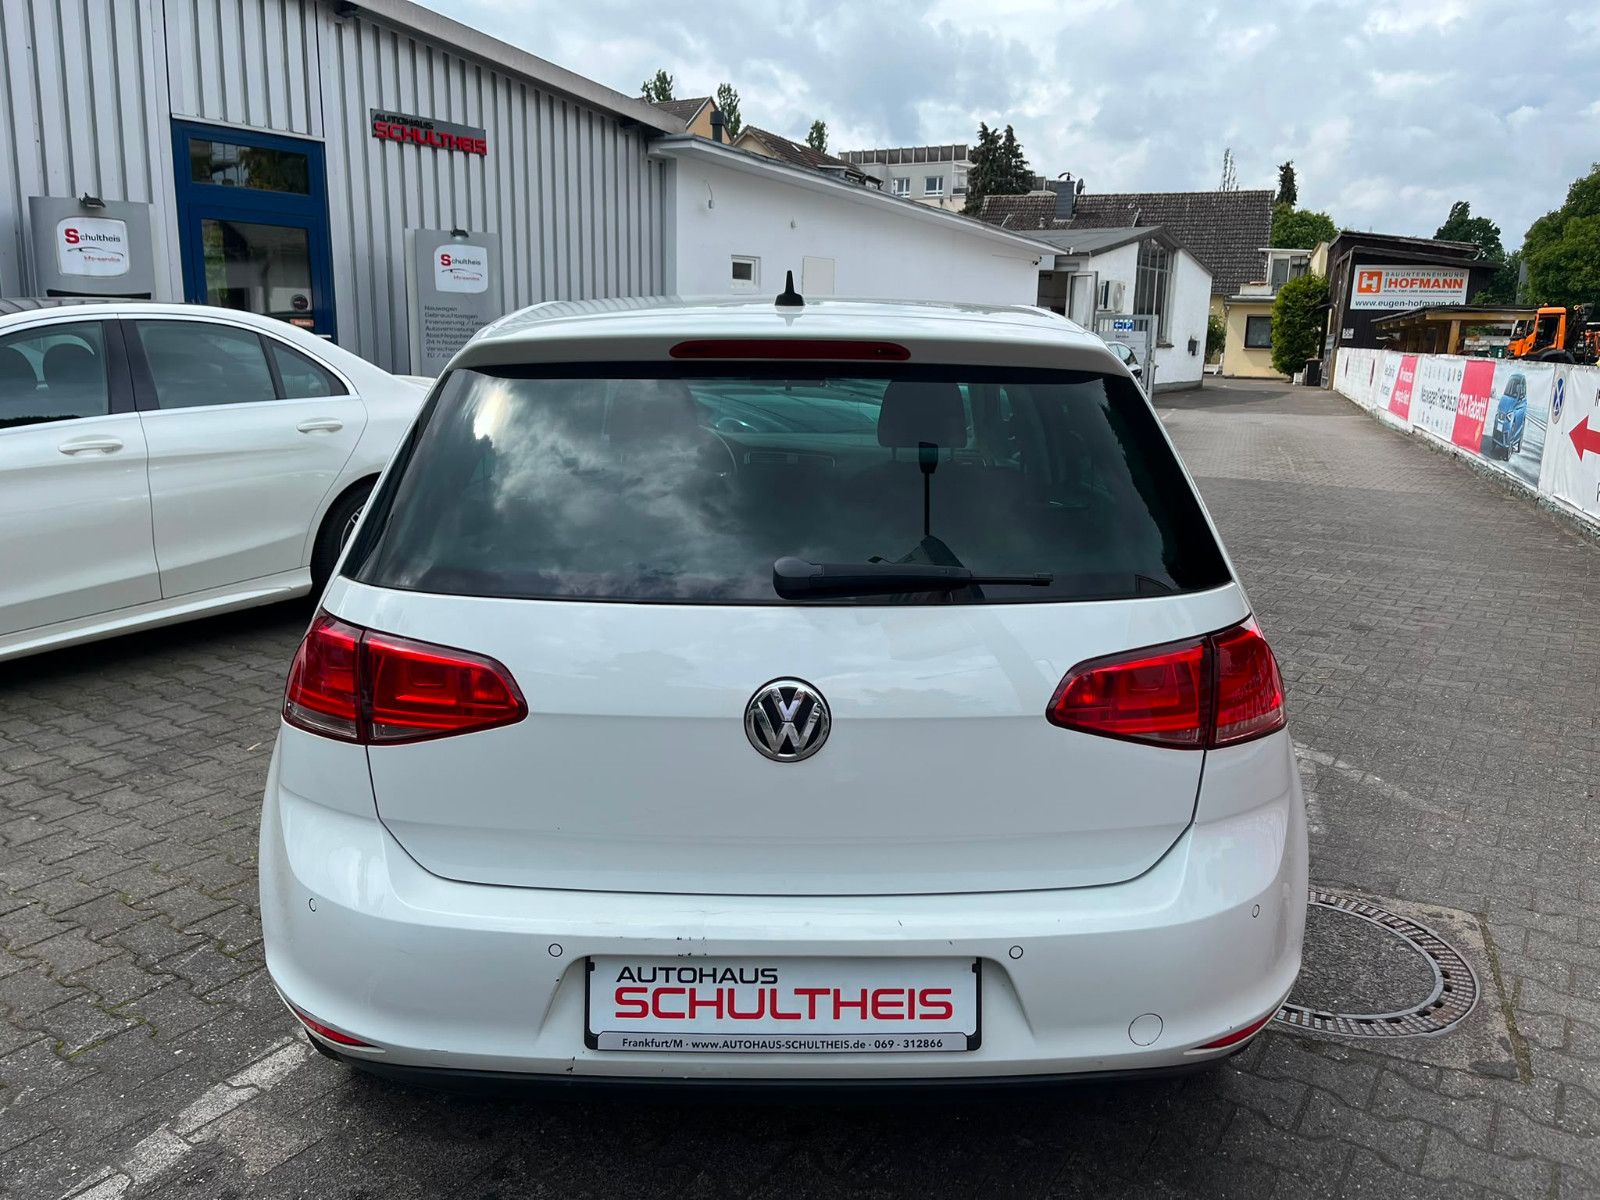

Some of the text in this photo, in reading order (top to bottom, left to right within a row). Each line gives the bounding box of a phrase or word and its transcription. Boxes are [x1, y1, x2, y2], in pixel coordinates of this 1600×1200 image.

[374, 113, 434, 130] AUTOHAUS
[373, 121, 488, 156] SCHULTHEIS
[64, 228, 121, 244] Schultheis
[440, 253, 481, 266] Schultheis
[1388, 278, 1463, 289] HOFMANN
[1355, 300, 1460, 308] www.eugen-hofmann.de
[616, 966, 779, 985] AUTOHAUS
[614, 986, 953, 1020] SCHULTHEIS
[622, 1038, 943, 1050] Frankfurt/M www.AUTOHAUS-SCHULTHEIS.de 069 312866
